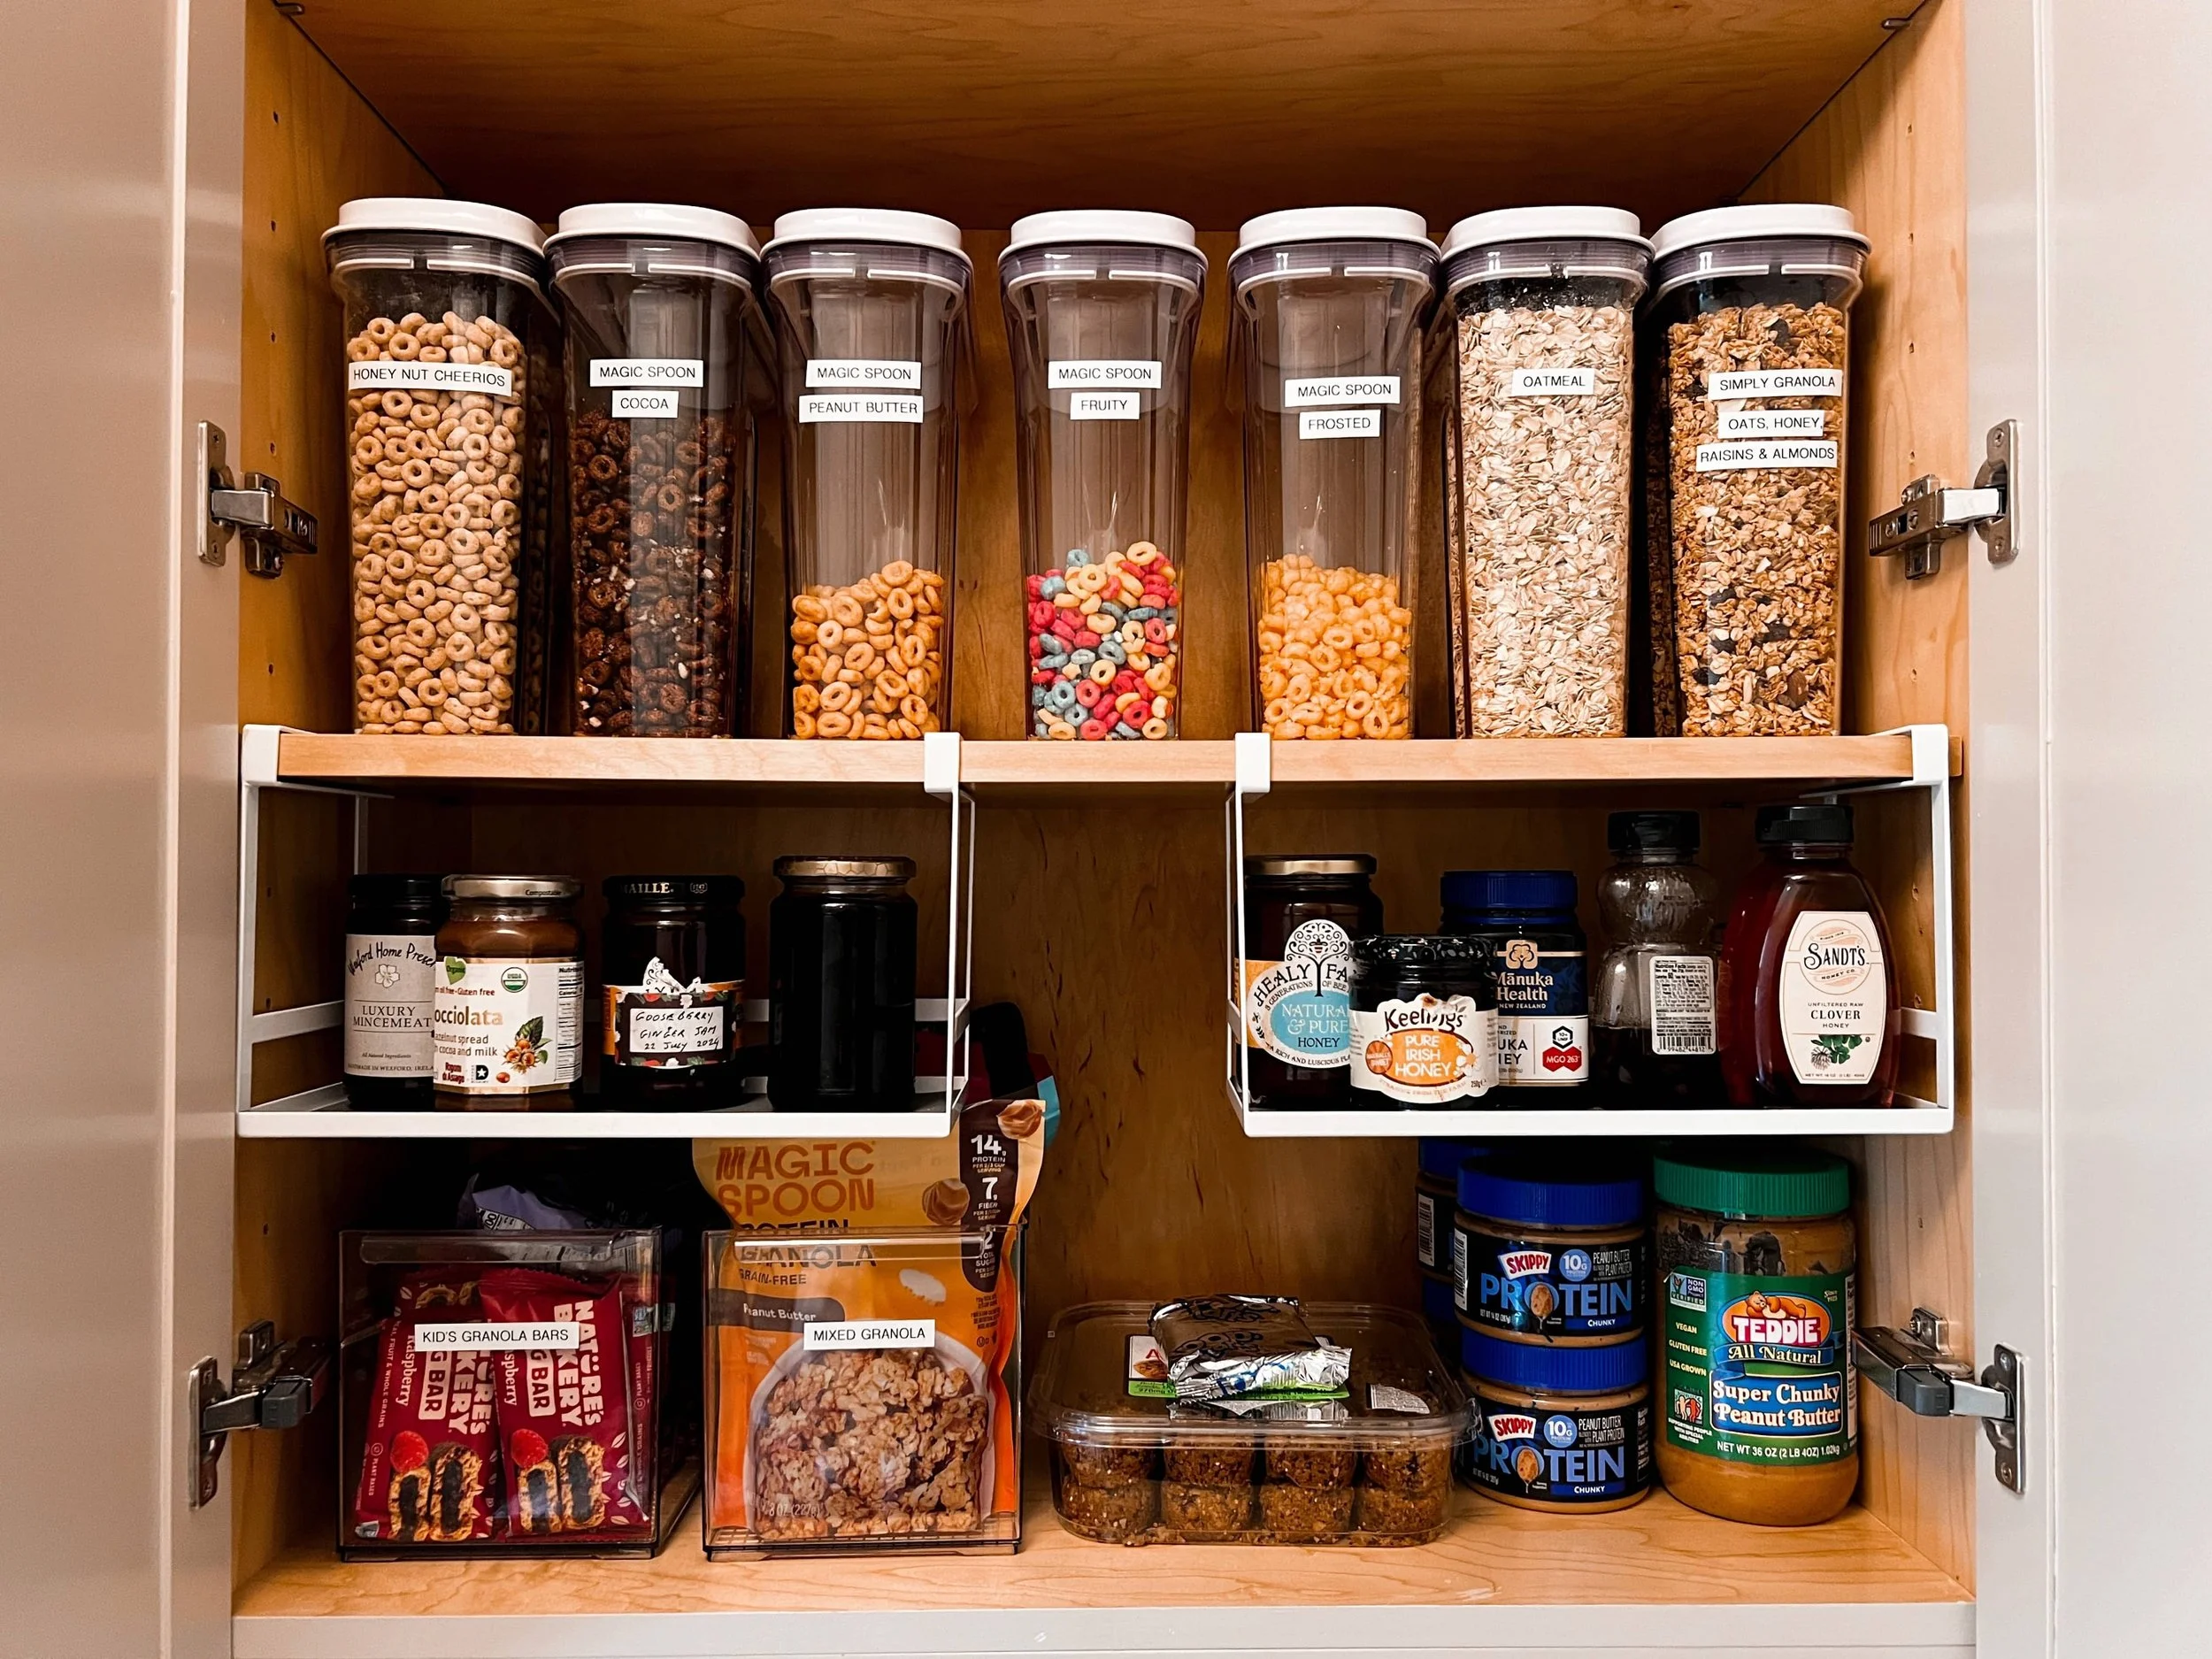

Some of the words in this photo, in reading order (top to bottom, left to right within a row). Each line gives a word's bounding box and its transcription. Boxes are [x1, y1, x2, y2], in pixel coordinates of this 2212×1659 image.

[353, 368, 396, 380] HONEY
[401, 369, 428, 381] NUT
[434, 370, 506, 388] CHEERIOS
[599, 365, 643, 379] MAGIC
[647, 366, 696, 379] SPOON
[817, 366, 860, 380] MAGIC
[864, 367, 912, 380] SPOON
[1058, 367, 1101, 380] MAGIC
[1105, 367, 1152, 380] SPOON
[1523, 375, 1586, 388] OATMEAL
[1719, 378, 1769, 391] SIMPLY
[1774, 375, 1836, 388] GRANOLA
[1298, 386, 1340, 398] MAGIC
[1345, 384, 1392, 396] SPOON
[620, 397, 669, 410] COCOA
[809, 402, 859, 414] PEANUT
[865, 402, 918, 414] BUTTER
[1080, 399, 1127, 411] FRUITY
[1308, 418, 1371, 431] FROSTED
[1728, 418, 1769, 430] OATS,
[1774, 417, 1824, 430] HONEY,
[1700, 448, 1754, 463] RAISINS
[1759, 449, 1768, 459] &
[1772, 448, 1835, 459] ALMONDS
[625, 882, 674, 894] AILLE.
[376, 941, 403, 958] Home
[1803, 942, 1866, 970] SANDT'S
[1254, 964, 1310, 1007] HEALY
[1269, 980, 1313, 1005] GENERATIONS
[1496, 987, 1548, 1002] Health
[362, 1005, 416, 1017] LUXURY
[434, 1005, 503, 1025] occiolata
[1810, 1010, 1861, 1019] CLOVER
[353, 1016, 432, 1027] MINCEMEAT
[1287, 1018, 1306, 1034] &
[1310, 1020, 1349, 1033] PURE
[695, 1025, 718, 1037] JAM
[457, 1034, 489, 1046] spread
[695, 1037, 719, 1050] 2024
[1298, 1037, 1340, 1048] HONEY
[1405, 1035, 1441, 1047] PURE
[474, 1047, 498, 1056] milk
[1406, 1049, 1441, 1061] IRISH
[1394, 1062, 1453, 1078] HONEY
[716, 1141, 875, 1181] MAGIC
[718, 1179, 875, 1219] SPOON
[1506, 1254, 1549, 1274] SKIPPY
[1594, 1251, 1613, 1263] PEANUT
[740, 1269, 807, 1285] GRAIN-FREE
[1481, 1272, 1632, 1317] PROTEIN
[1671, 1293, 1704, 1305] VERIFIED
[743, 1303, 777, 1318] Peanut
[778, 1309, 816, 1322] Butter
[422, 1331, 457, 1343] KID'S
[462, 1329, 527, 1342] GRANOLA
[532, 1328, 569, 1341] BARS
[813, 1329, 856, 1341] MIXED
[861, 1327, 926, 1340] GRANOLA
[1675, 1322, 1698, 1334] VEGAN
[1732, 1317, 1819, 1344] TEDDIE
[388, 1338, 396, 1360] FRUIT
[1669, 1340, 1691, 1353] GLUTEN
[1691, 1345, 1708, 1356] FREE
[1728, 1345, 1755, 1360] All
[1758, 1345, 1822, 1365] Natural
[554, 1303, 583, 1427] BKERY
[1669, 1359, 1680, 1370] USA
[1680, 1363, 1707, 1377] GROWN
[383, 1370, 392, 1397] WHOLE
[424, 1369, 446, 1412] BAR
[531, 1367, 550, 1409] BAR
[1712, 1379, 1771, 1404] Super
[1776, 1383, 1840, 1404] Chunky
[378, 1398, 389, 1428] GRAINS
[1713, 1402, 1786, 1426] Peanut
[1787, 1407, 1841, 1427] Butter
[1494, 1418, 1533, 1437] SKIPPY
[1578, 1418, 1601, 1431] PEANUT
[1602, 1415, 1622, 1430] BUTTER
[1593, 1430, 1607, 1442] PLANT
[1608, 1428, 1624, 1442] PROTEIN
[1717, 1440, 1735, 1453] NET
[1736, 1443, 1750, 1455] WT
[1752, 1446, 1763, 1456] 36
[1764, 1447, 1778, 1457] OZ
[1778, 1448, 1787, 1459] (2
[1789, 1448, 1801, 1457] LB
[1473, 1434, 1624, 1482] PROTEIN
